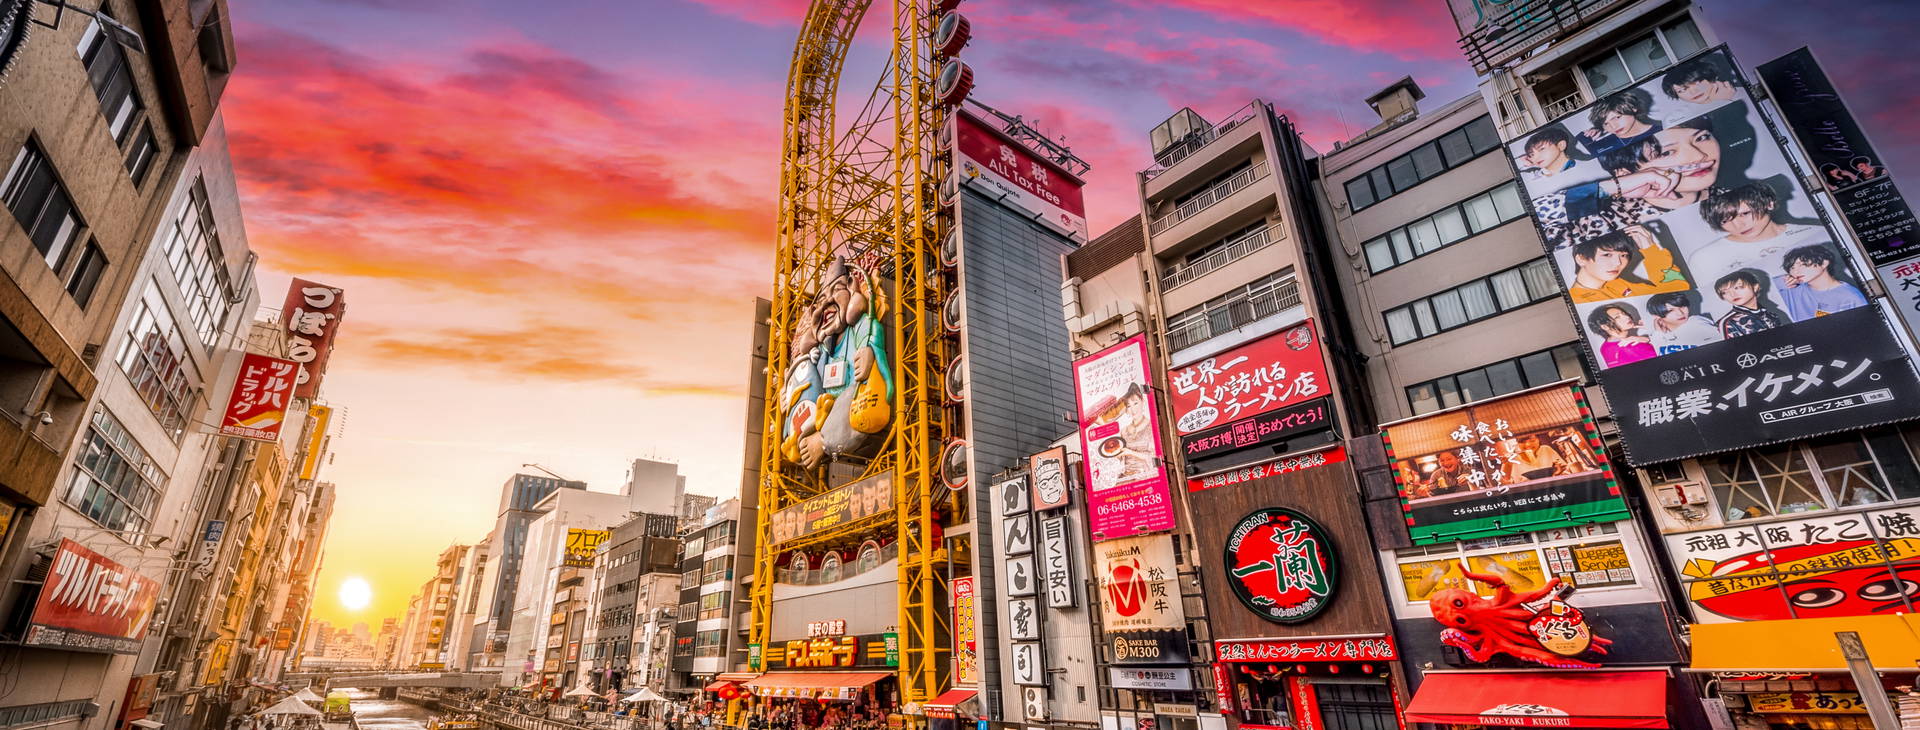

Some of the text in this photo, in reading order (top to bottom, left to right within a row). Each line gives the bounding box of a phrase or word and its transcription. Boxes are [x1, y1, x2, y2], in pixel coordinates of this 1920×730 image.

[1000, 145, 1048, 185] 免税
[1013, 172, 1033, 191] Tax
[1037, 185, 1061, 205] Free
[1759, 344, 1814, 364] AGE
[1770, 344, 1794, 353] CLUB
[233, 365, 267, 415] ドラッグ
[258, 361, 293, 409] ツルハ
[1173, 355, 1249, 396] 世界一
[1196, 361, 1286, 408] 人が訪れる
[1682, 363, 1726, 381] AIR
[1224, 371, 1318, 420] ラーメン店
[1638, 358, 1881, 428] 職業、イケメン。
[1781, 398, 1854, 419] AIR グループ 大阪
[1187, 430, 1233, 454] 大阪万博
[1237, 432, 1258, 444] 決定
[1475, 420, 1510, 496] 食べたいから
[1494, 418, 1521, 465] おいしく
[1097, 493, 1162, 516] 06-6468-4538
[1229, 512, 1269, 553] ICHIRAN
[1553, 526, 1595, 540] 2 F
[1045, 518, 1067, 604] 旨くて安い
[1232, 520, 1330, 597] 一蘭
[1576, 546, 1624, 560] Luggage
[1581, 558, 1627, 571] Service
[49, 548, 142, 620] ツルハドラッグ
[1148, 566, 1169, 615] 松阪牛
[1129, 647, 1159, 658] M300
[1218, 639, 1394, 661] 天然とんこつラーメン専門店
[1478, 716, 1570, 726] TAKO-YAKI KUKURU
